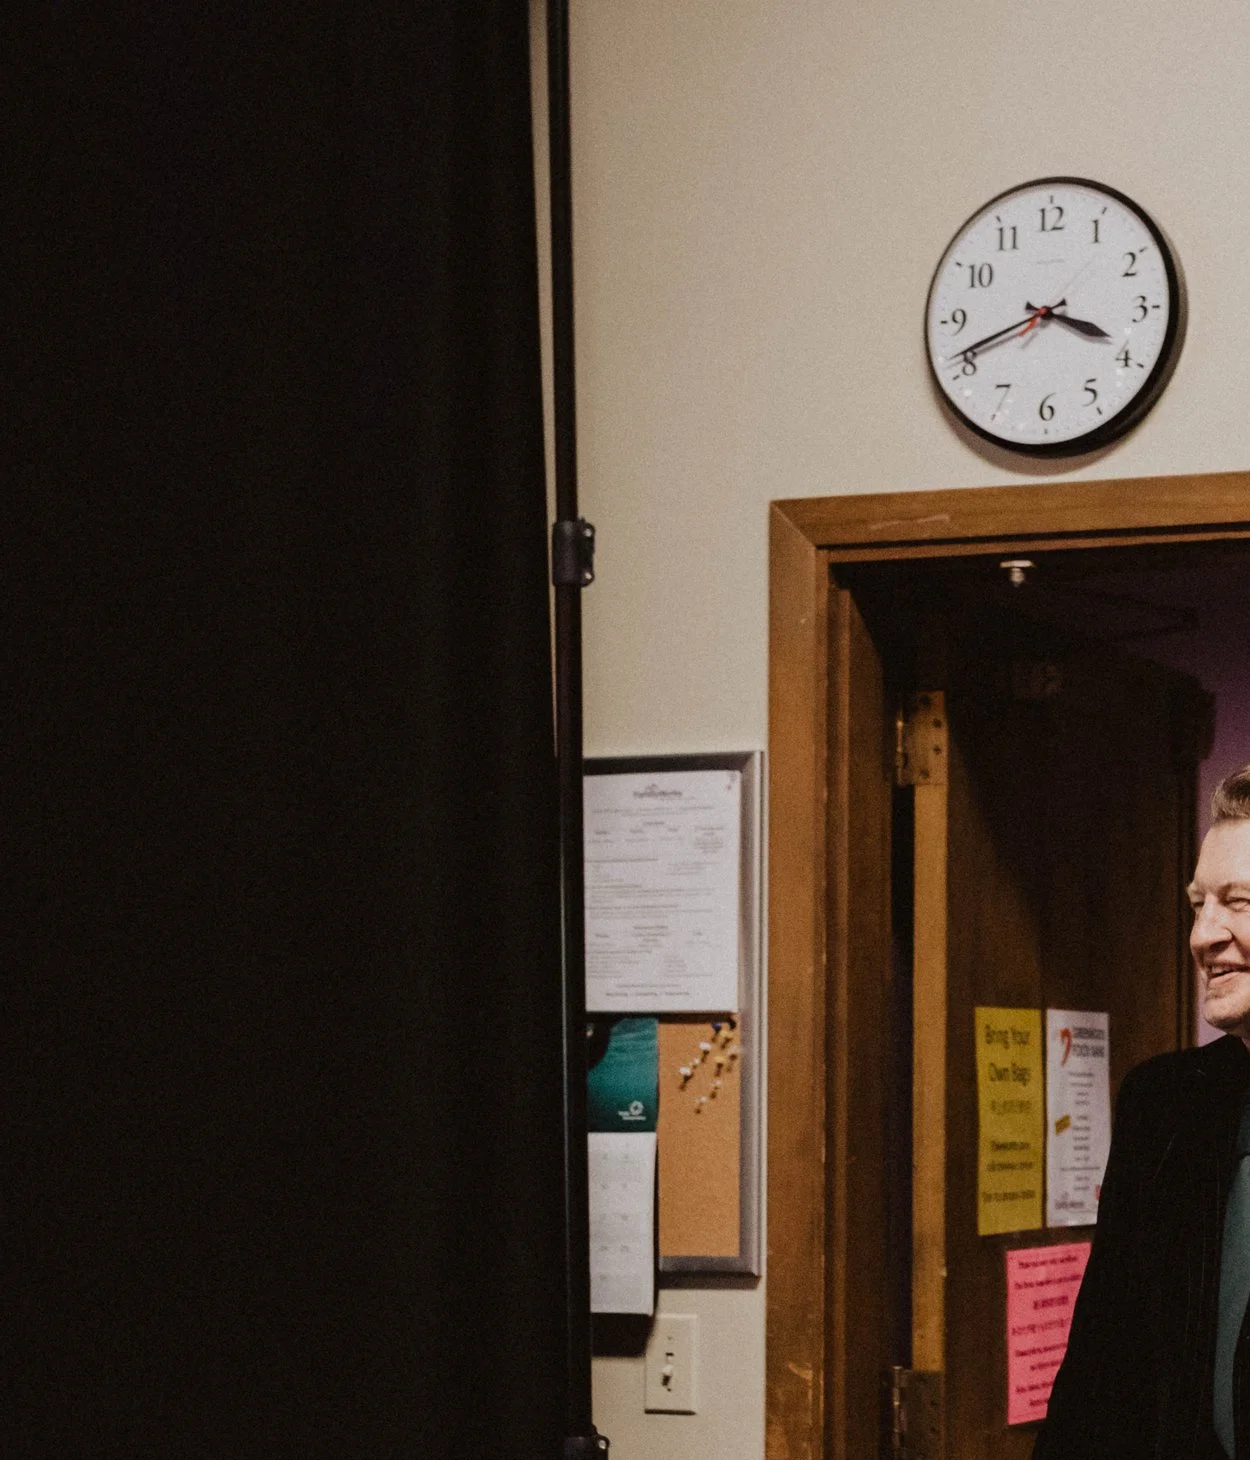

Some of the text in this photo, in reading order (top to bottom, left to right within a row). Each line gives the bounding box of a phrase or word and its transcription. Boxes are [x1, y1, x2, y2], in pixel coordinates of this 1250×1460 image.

[1038, 206, 1065, 233] 12
[1091, 219, 1101, 244] 1
[997, 226, 1020, 252] 11
[967, 263, 994, 289] 10
[1122, 251, 1137, 278] 2
[951, 308, 967, 336] 9
[1131, 295, 1148, 323] 3
[961, 350, 977, 377] 8
[1115, 340, 1132, 369] 4
[995, 383, 1012, 411] 7
[1082, 378, 1098, 407] 5
[1039, 392, 1055, 422] 6
